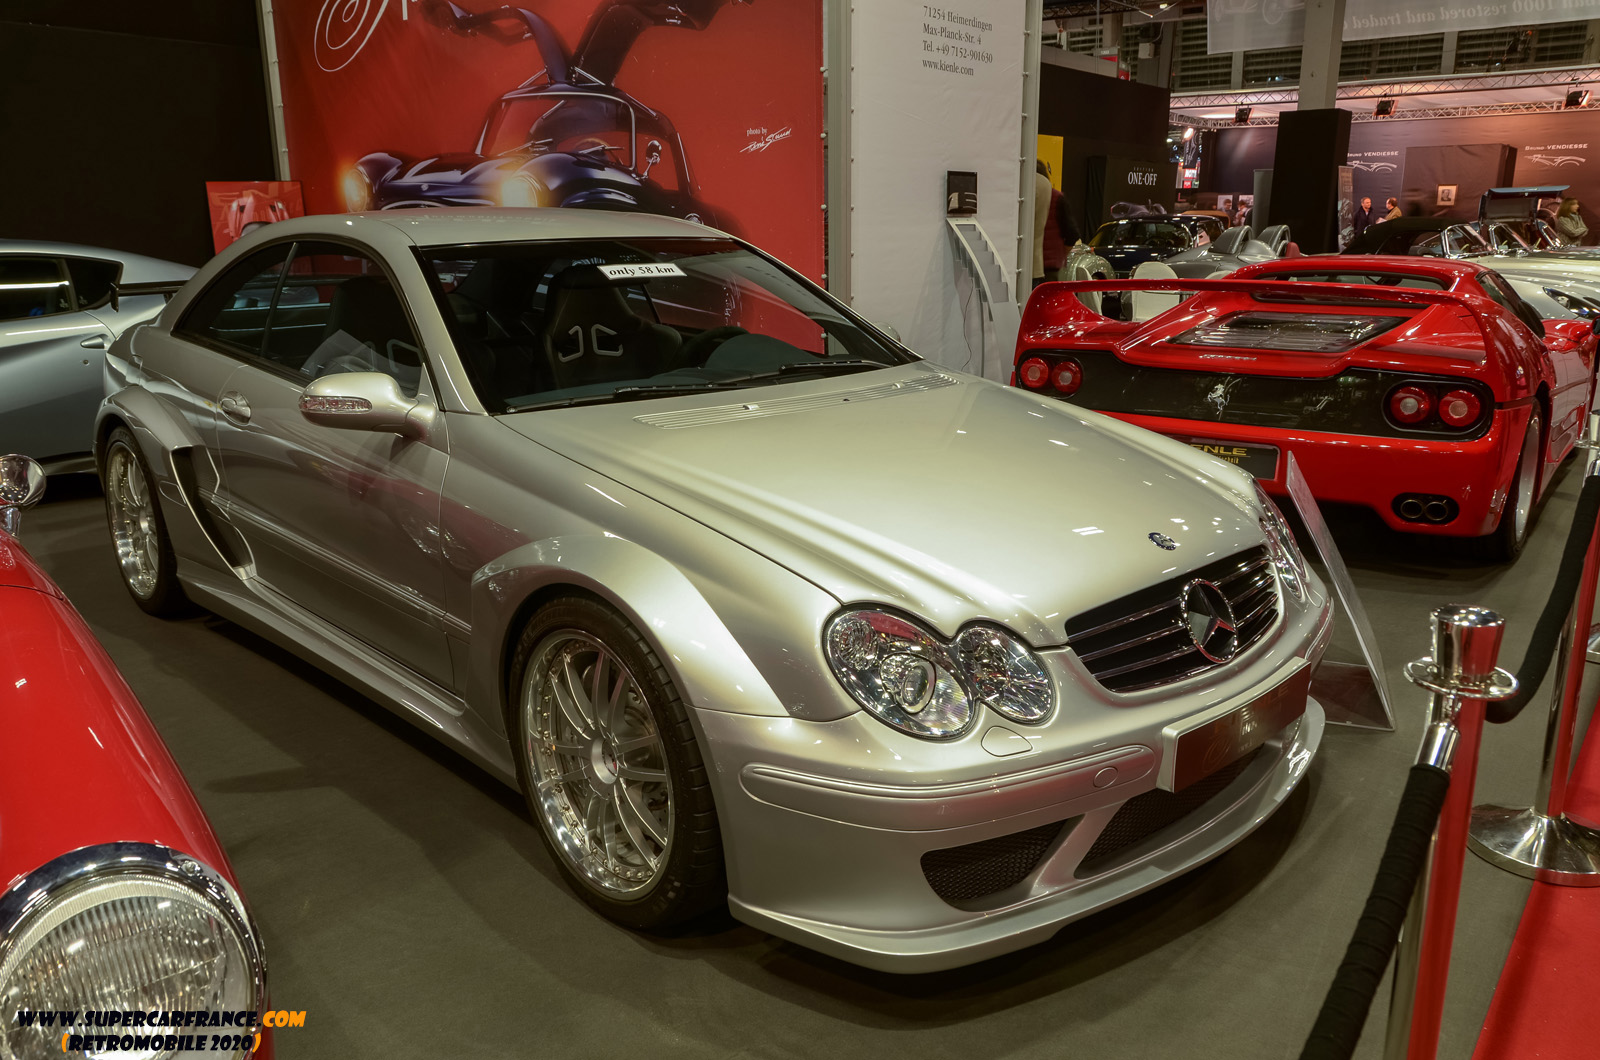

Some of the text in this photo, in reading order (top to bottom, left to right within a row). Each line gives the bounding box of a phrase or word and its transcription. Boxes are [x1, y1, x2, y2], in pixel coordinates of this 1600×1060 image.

[923, 5, 993, 32] 71254 Heimerdingen
[923, 23, 982, 45] Max-Planck-Str. 4
[923, 40, 993, 64] Tel. +49 7152-901630
[922, 59, 974, 76] www.kienle.com
[746, 127, 768, 137] photo by
[609, 265, 675, 277] only 58 km
